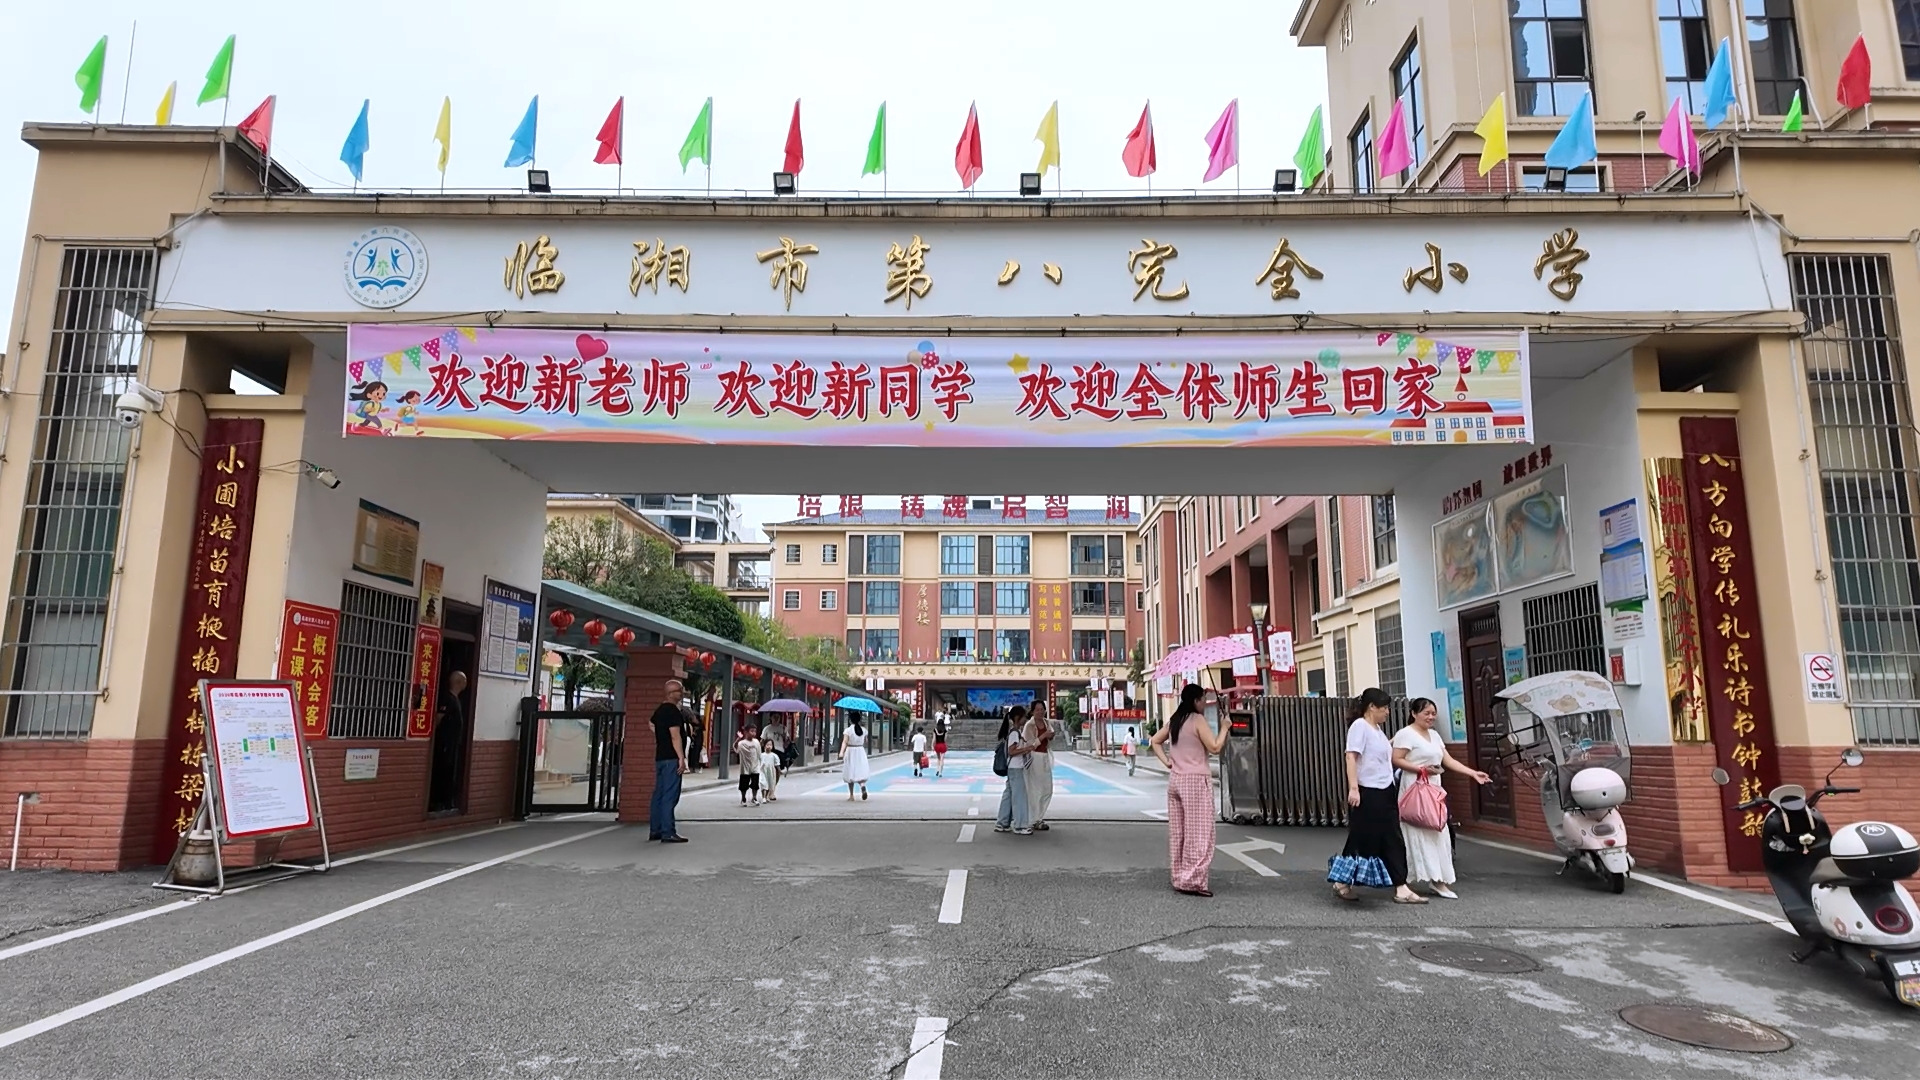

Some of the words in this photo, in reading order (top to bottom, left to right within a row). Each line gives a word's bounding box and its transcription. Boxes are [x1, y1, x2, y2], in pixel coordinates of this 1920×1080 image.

[504, 227, 1590, 310] 临湘市第八完全小学
[424, 352, 690, 419] 欢迎新老师
[713, 360, 976, 422] 欢迎新同学
[1015, 358, 1450, 423] 欢迎全体师生回家
[797, 495, 863, 519] 培根
[900, 495, 969, 519] 铸魂
[1001, 495, 1069, 519] 启智
[1038, 584, 1048, 632] 写规范字
[1052, 584, 1062, 632] 说普通话
[305, 633, 327, 727] 概不会客
